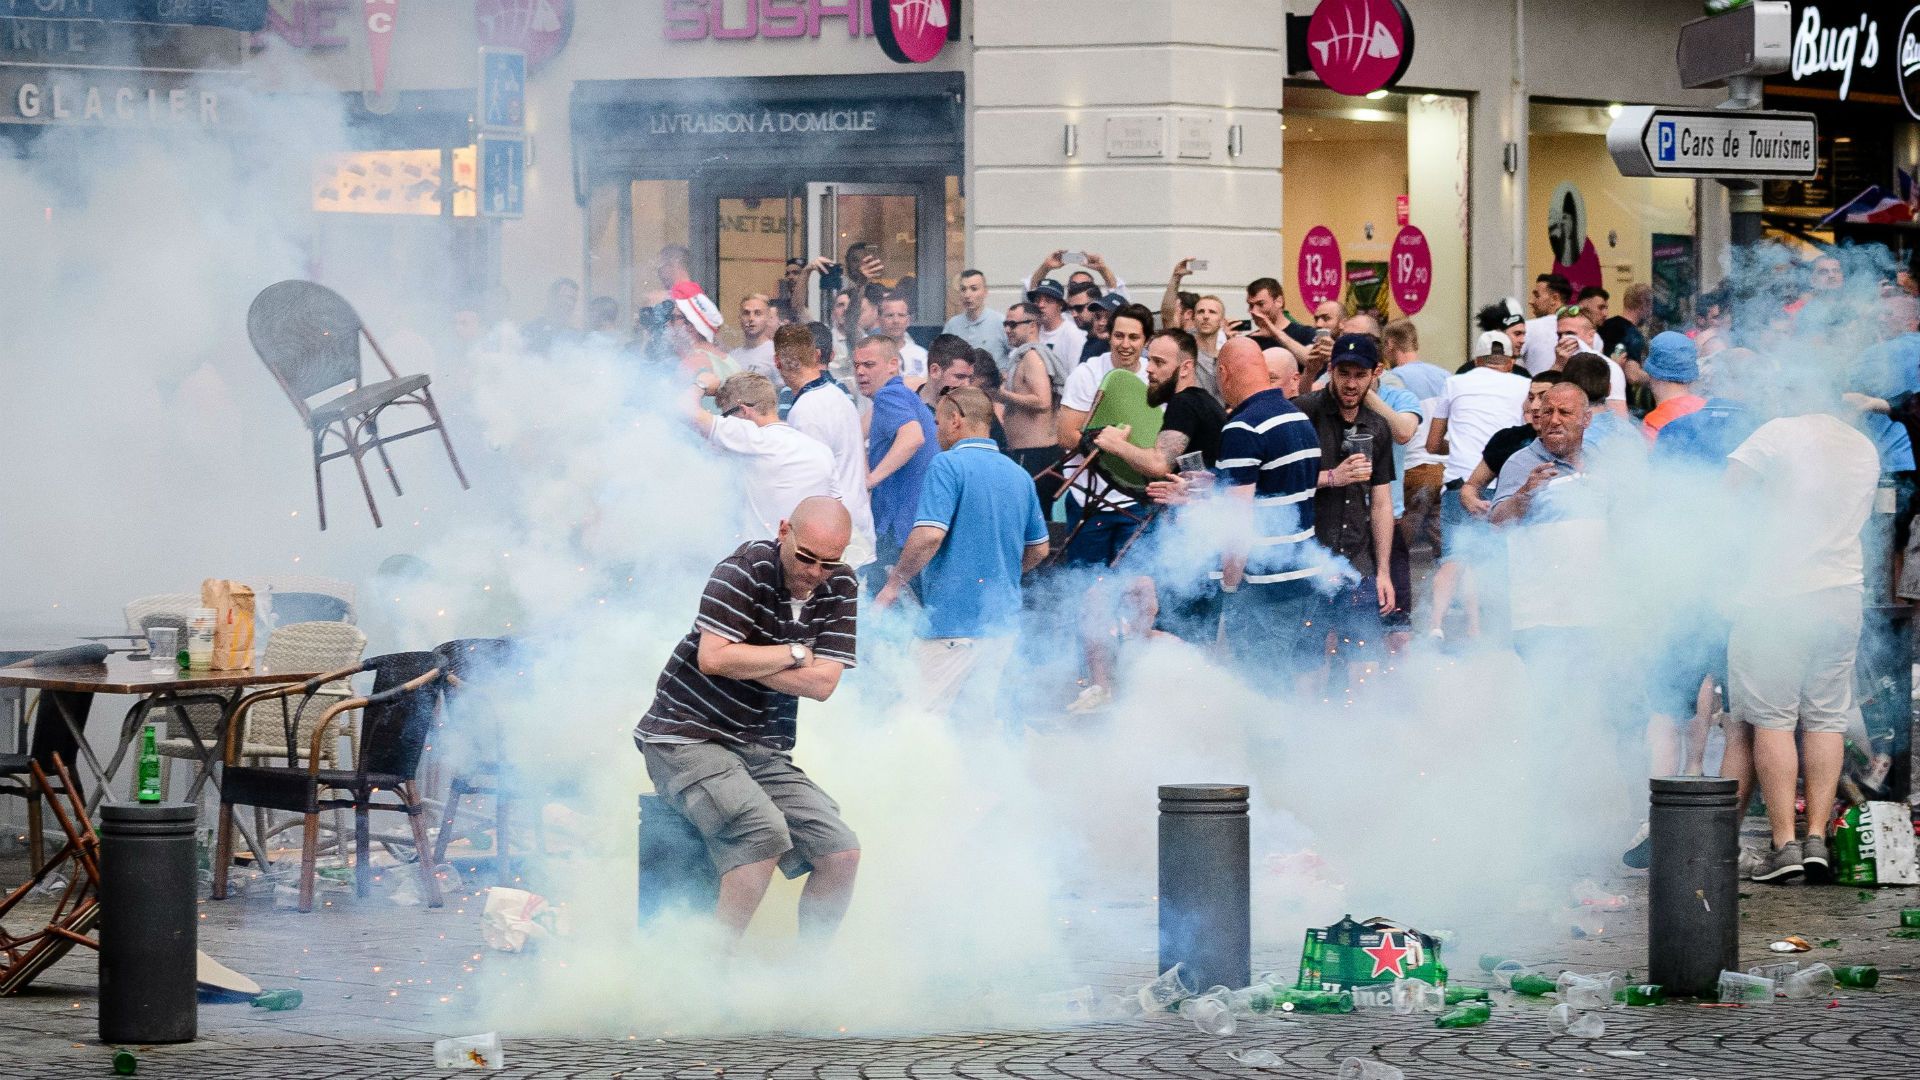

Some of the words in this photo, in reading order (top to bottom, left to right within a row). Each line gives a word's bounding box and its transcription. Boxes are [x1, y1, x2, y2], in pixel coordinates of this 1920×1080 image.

[1791, 6, 1879, 101] Bug's
[18, 83, 220, 124] GLACIER
[651, 112, 755, 133] LIVRAISON
[1681, 128, 1714, 158] Cars
[1723, 129, 1740, 158] de
[1749, 130, 1811, 160] Tourisme
